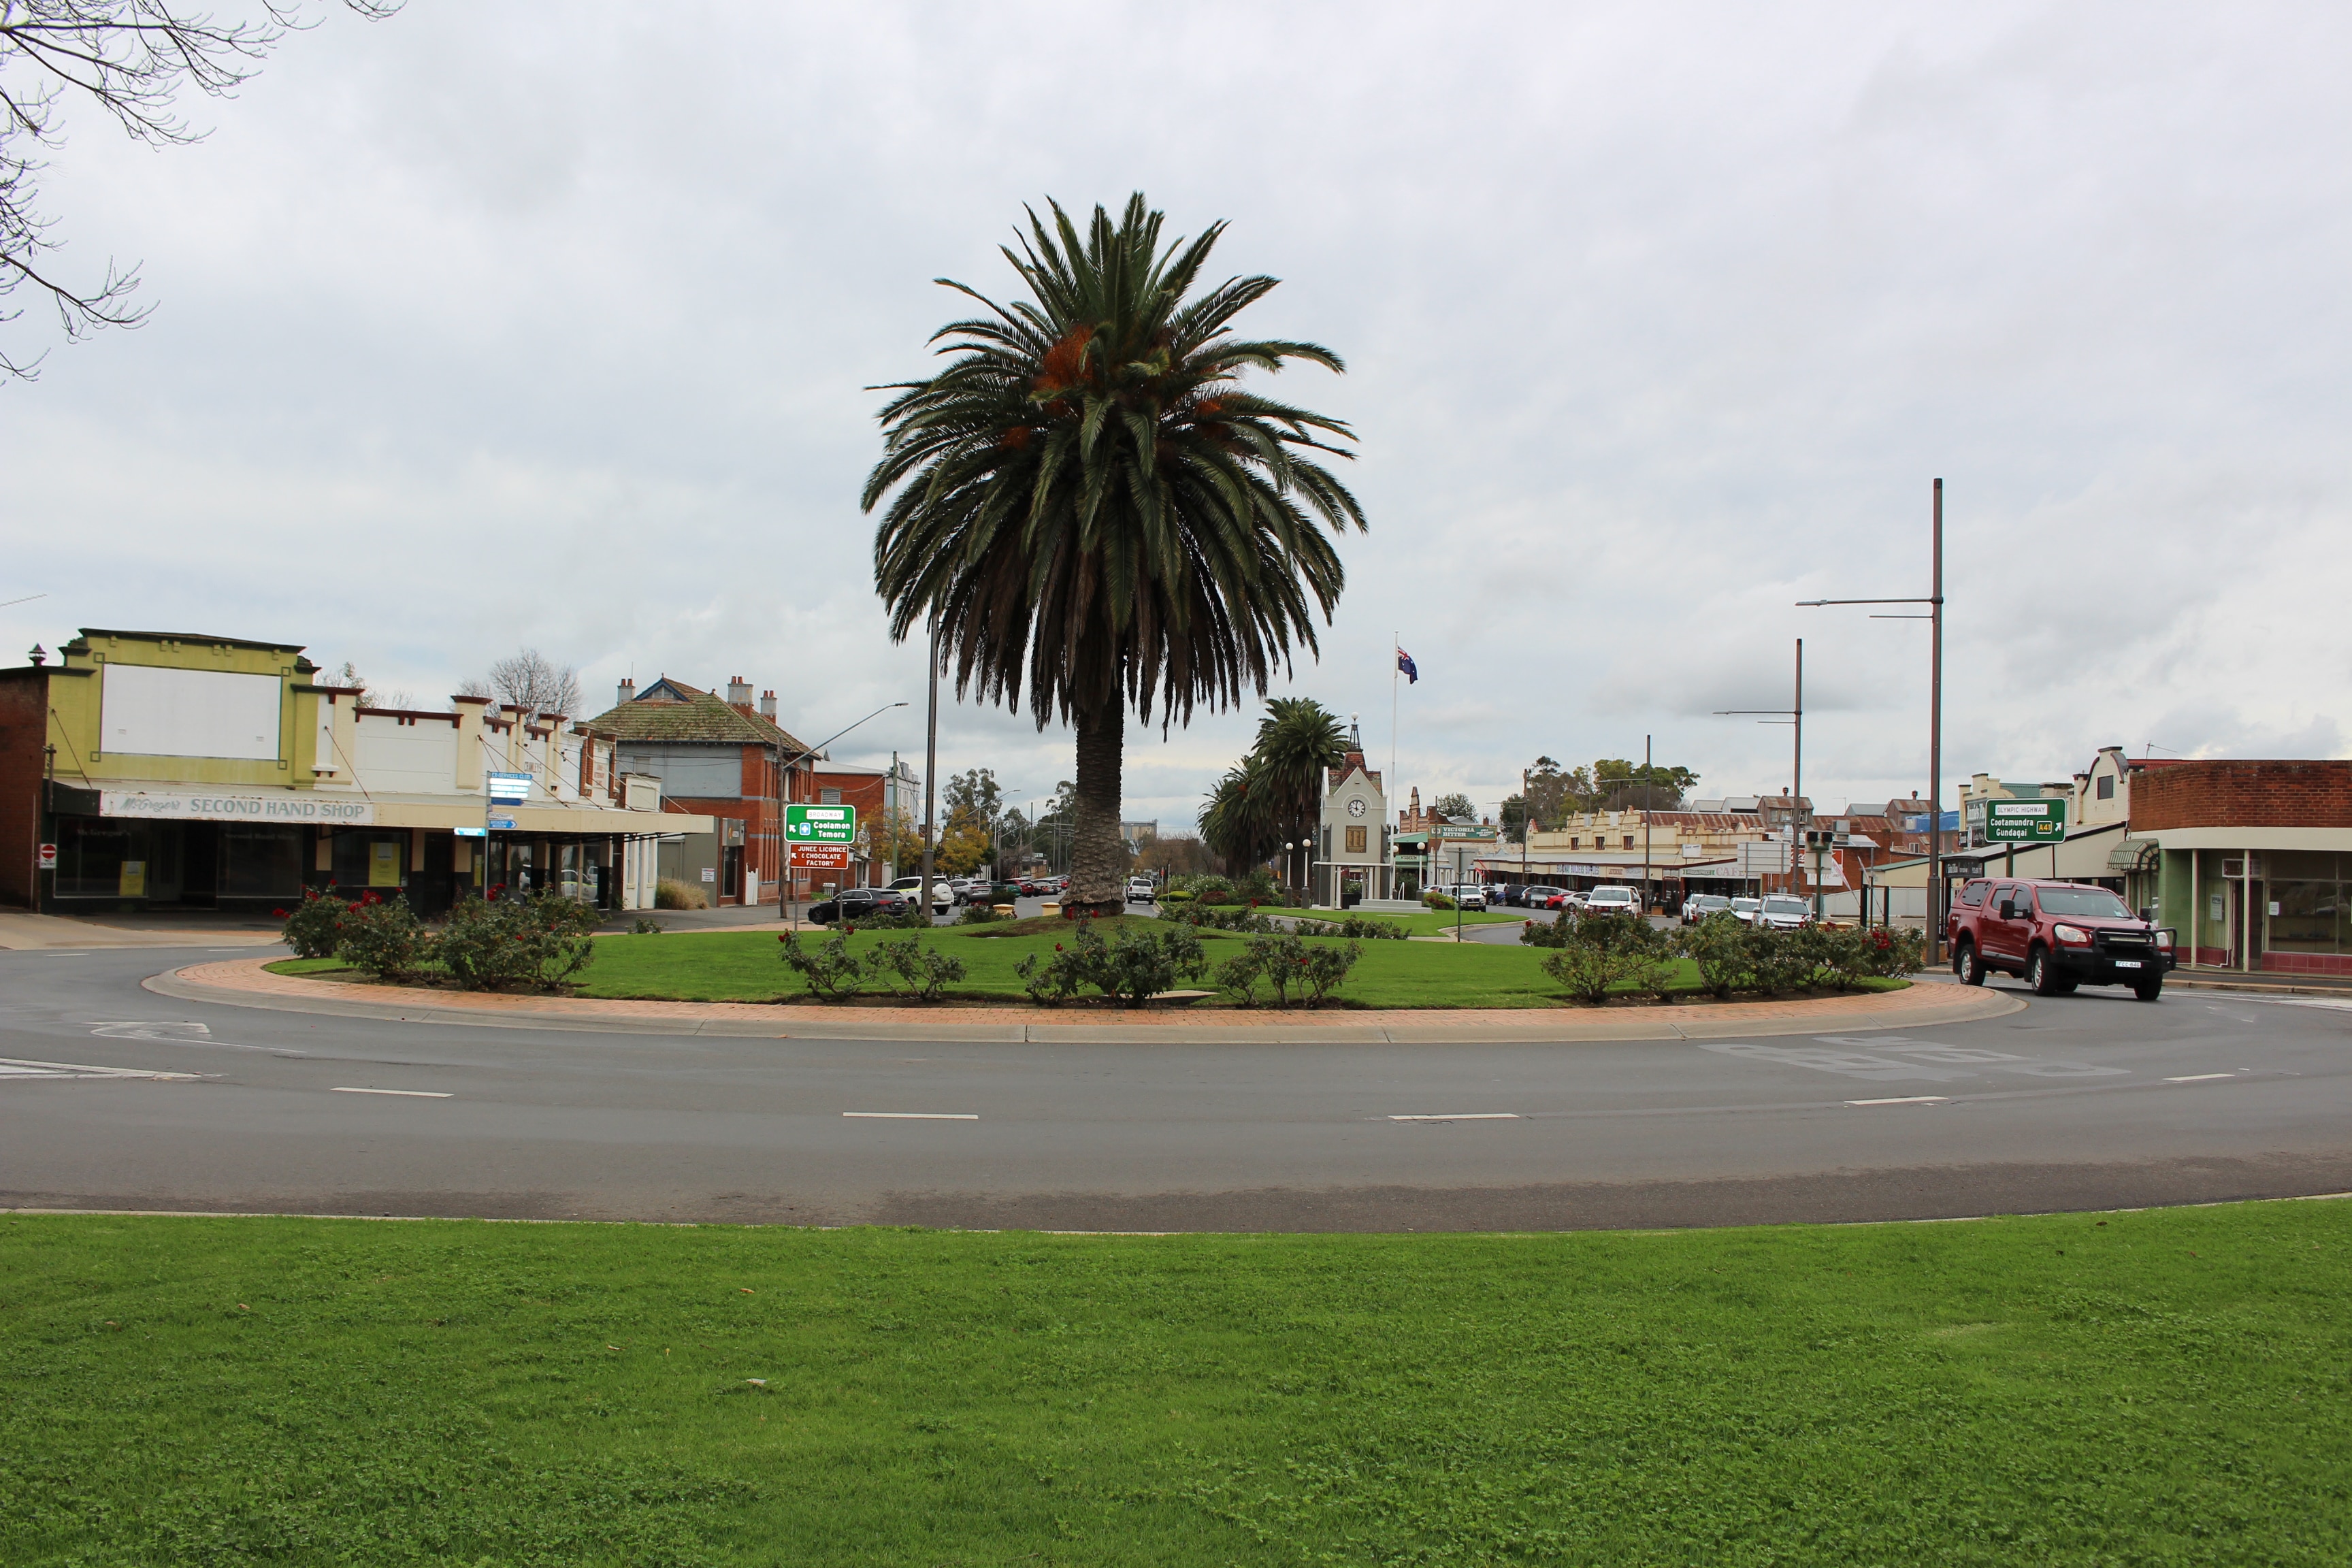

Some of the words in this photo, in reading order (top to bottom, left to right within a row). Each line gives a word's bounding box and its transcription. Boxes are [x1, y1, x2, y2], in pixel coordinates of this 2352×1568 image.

[191, 798, 261, 815] SECOND
[265, 801, 316, 816] HAND
[321, 804, 365, 817] SHOP
[813, 821, 851, 830] Coolamon
[1990, 818, 2034, 827] Cootamundra
[2038, 823, 2051, 832] A41
[817, 830, 846, 838] Temora
[1995, 828, 2027, 839] Gundagai
